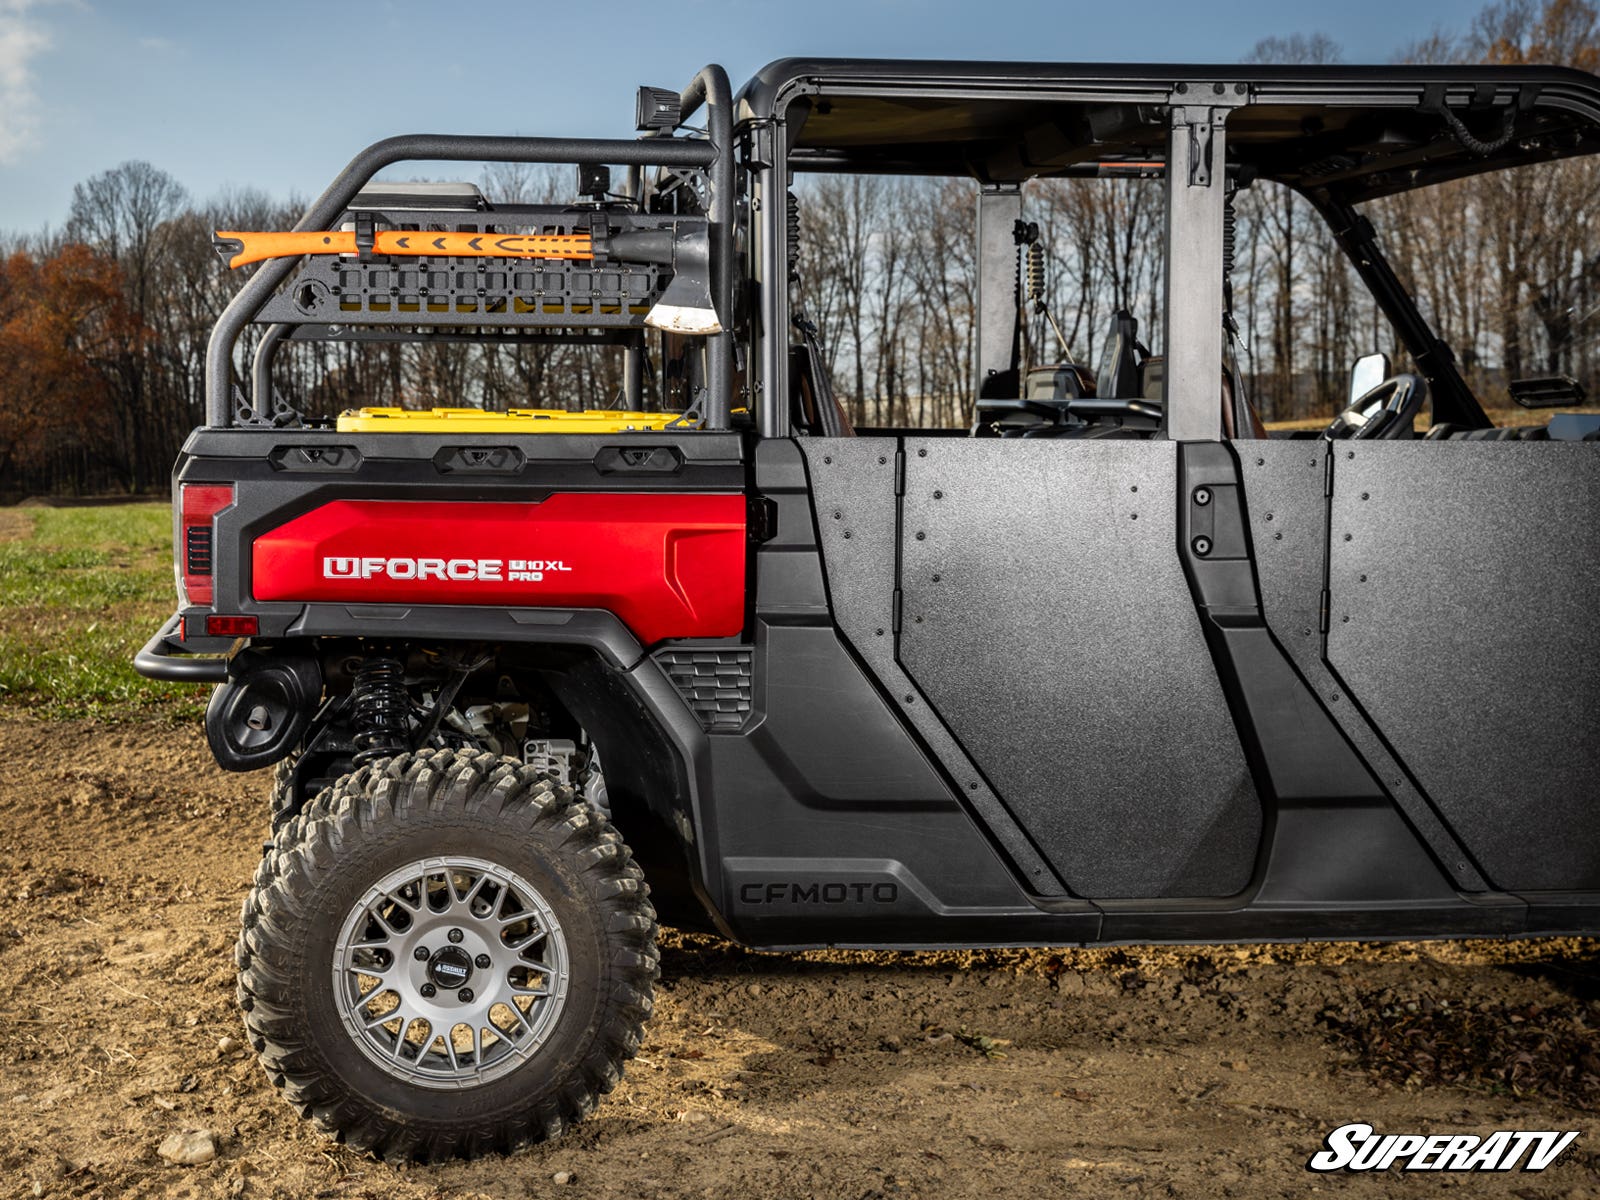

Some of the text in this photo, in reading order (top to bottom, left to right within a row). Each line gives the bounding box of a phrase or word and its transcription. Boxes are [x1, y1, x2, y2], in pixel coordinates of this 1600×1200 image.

[323, 557, 503, 581] UFORCE
[508, 571, 543, 581] PRO
[740, 883, 899, 904] CFMOTO
